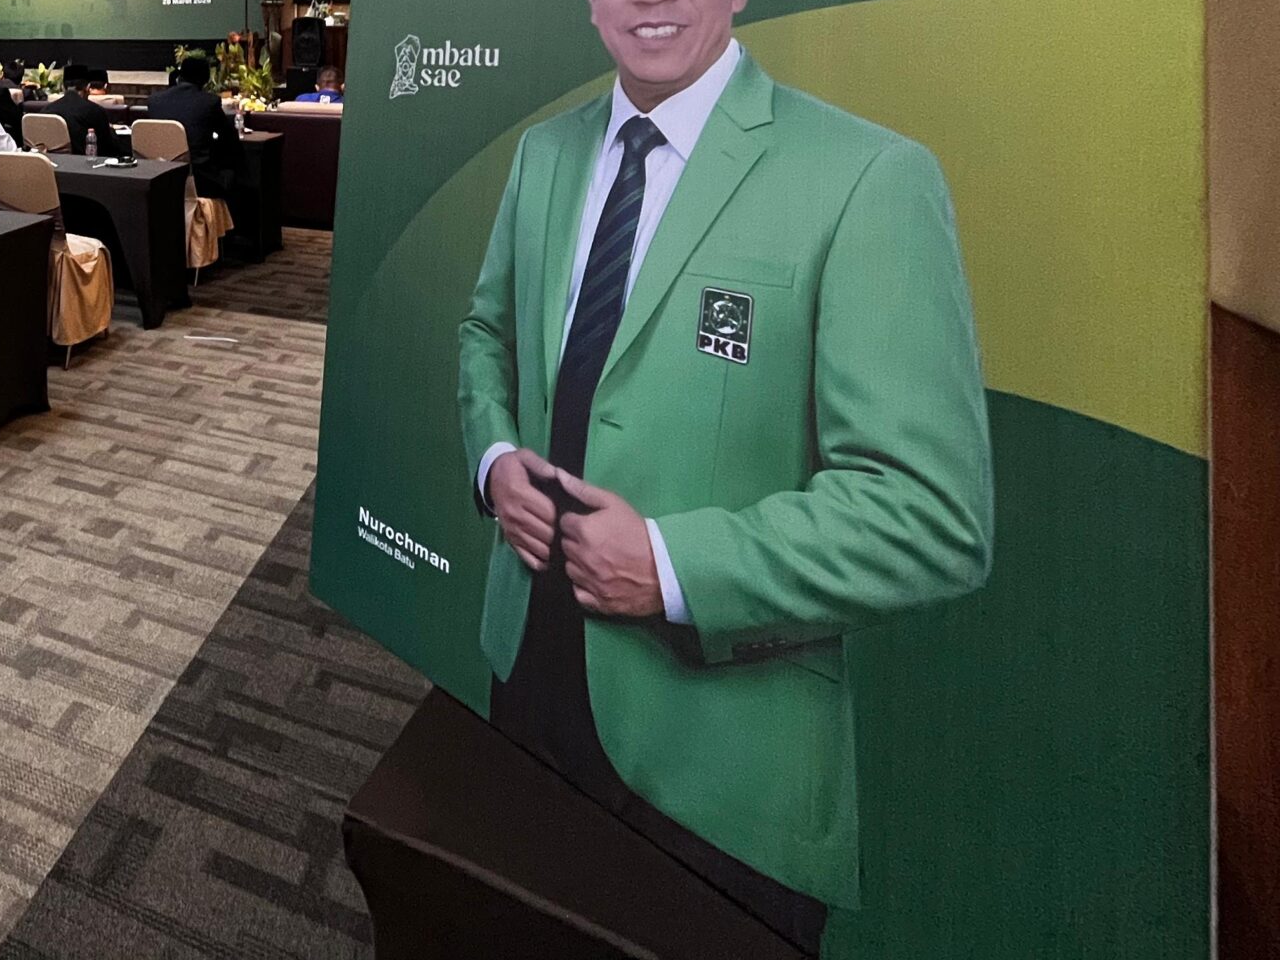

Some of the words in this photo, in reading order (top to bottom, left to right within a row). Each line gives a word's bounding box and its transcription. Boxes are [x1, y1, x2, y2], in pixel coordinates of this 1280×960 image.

[422, 40, 500, 67] mbatu
[420, 68, 461, 87] sae
[699, 334, 747, 362] PKB
[357, 526, 393, 556] Walikota
[394, 548, 415, 570] Batu
[359, 506, 450, 574] Nurochman
